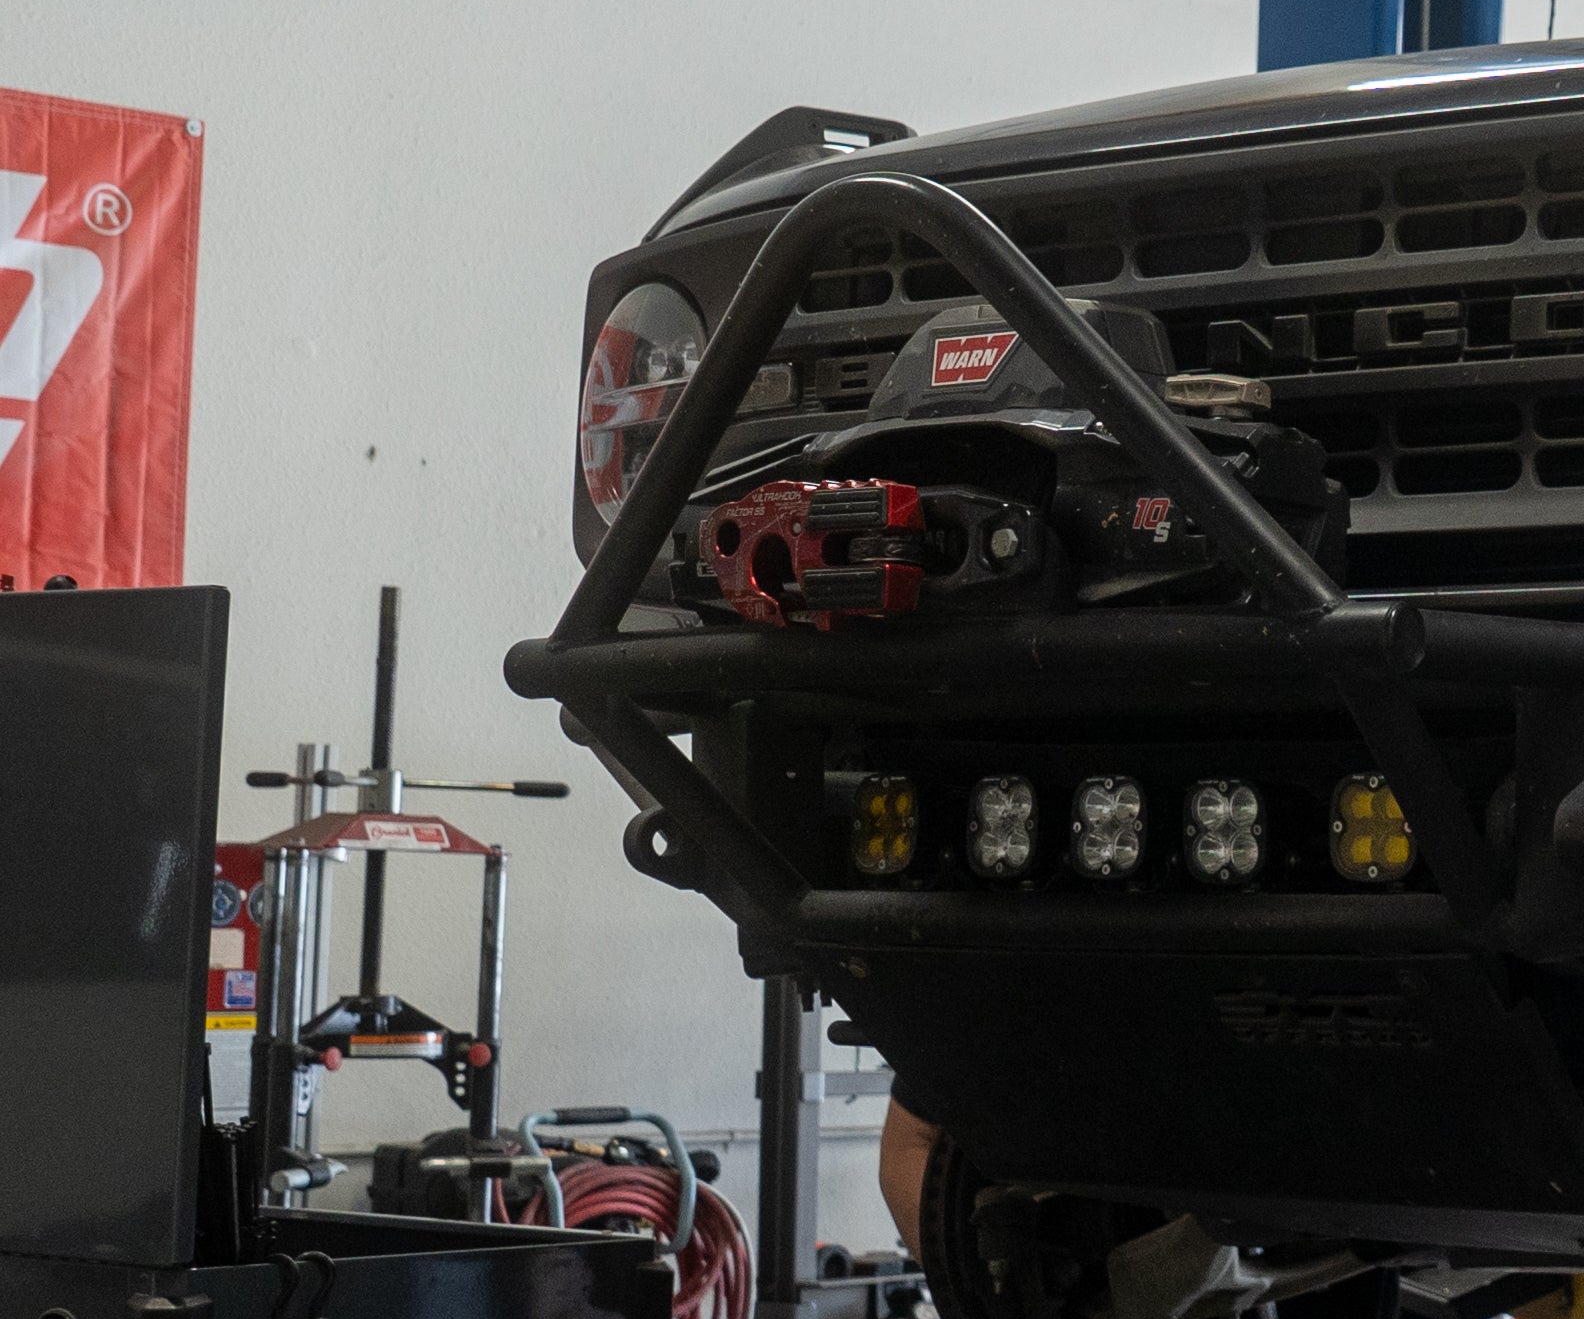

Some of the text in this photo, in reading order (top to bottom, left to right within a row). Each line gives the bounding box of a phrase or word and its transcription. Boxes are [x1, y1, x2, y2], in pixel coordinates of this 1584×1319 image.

[939, 347, 999, 370] WARN
[727, 508, 753, 517] FACTOR
[1132, 497, 1171, 529] 10
